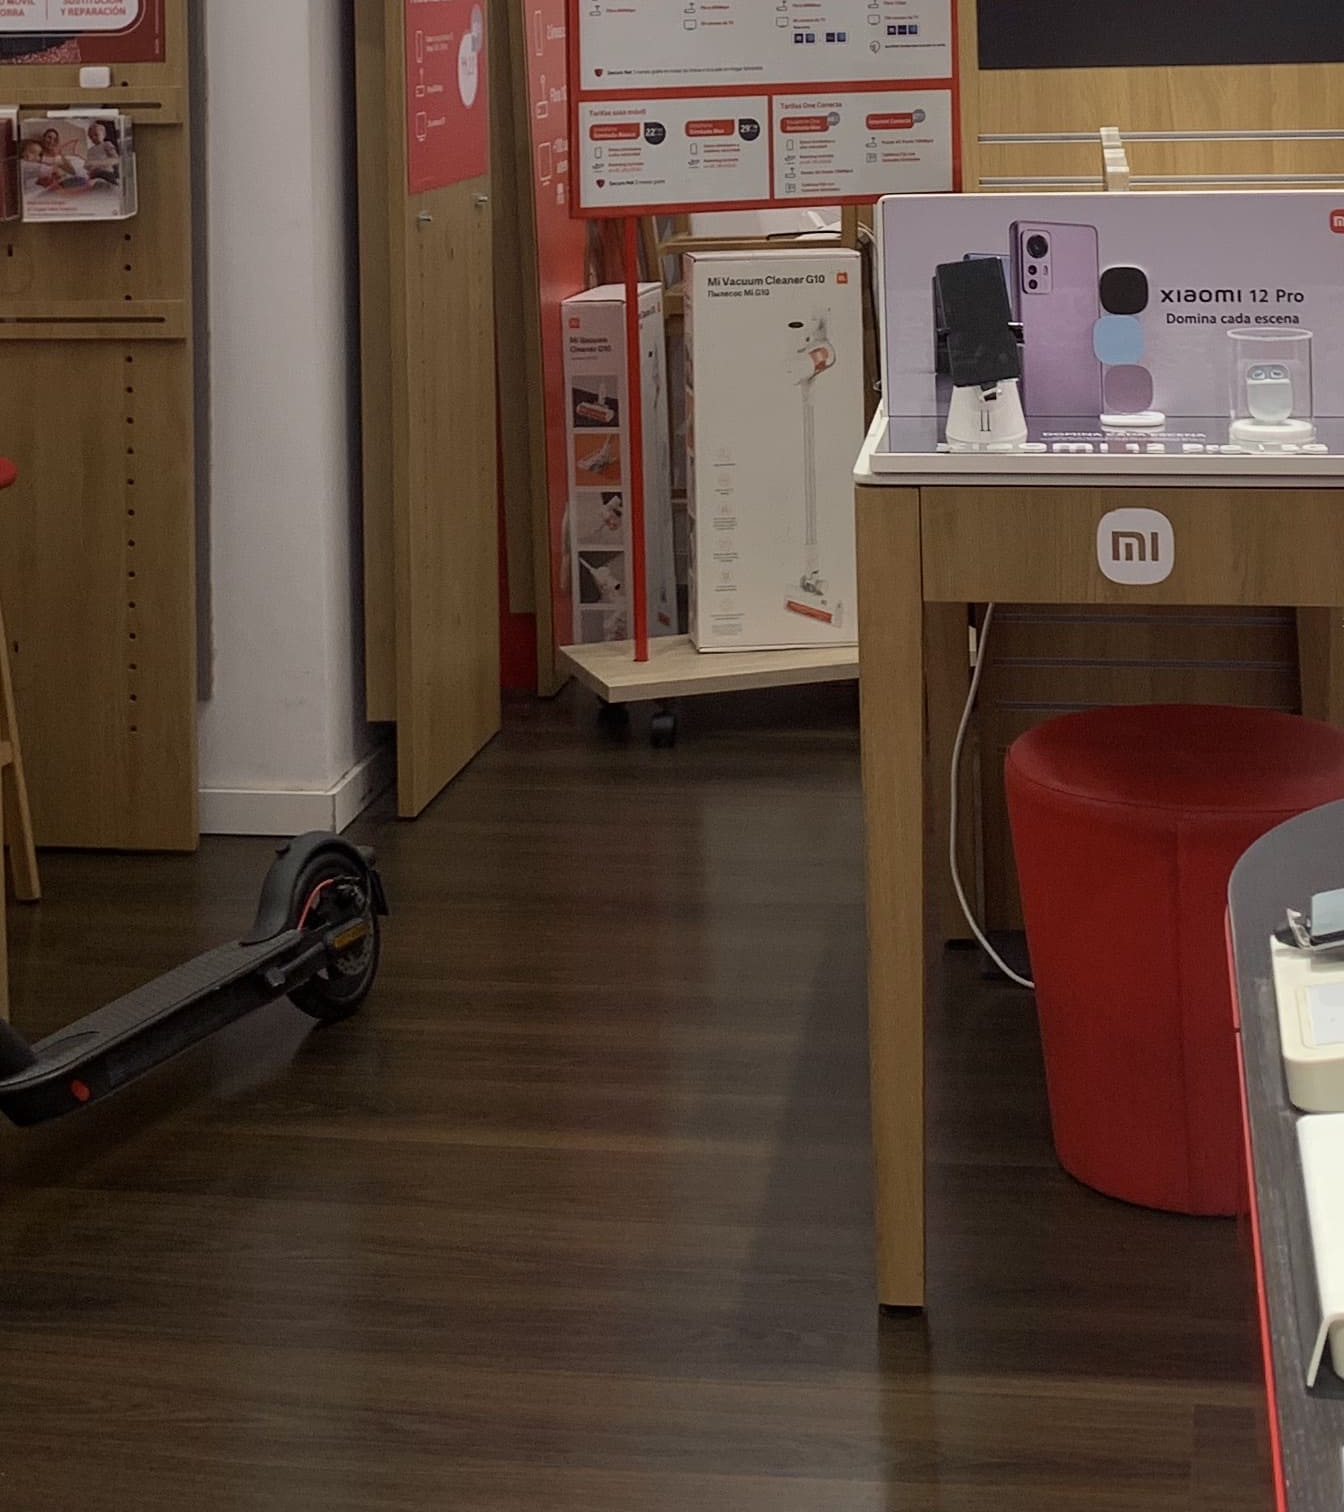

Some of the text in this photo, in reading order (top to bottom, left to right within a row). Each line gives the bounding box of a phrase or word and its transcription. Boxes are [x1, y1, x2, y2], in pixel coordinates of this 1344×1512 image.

[68, 5, 126, 16] REPARACIÓN
[708, 274, 825, 286] Mi Vacuum Cleaner G10
[1250, 289, 1268, 303] 12
[1276, 289, 1304, 303] Pro
[1166, 313, 1299, 324] Domina cada escena
